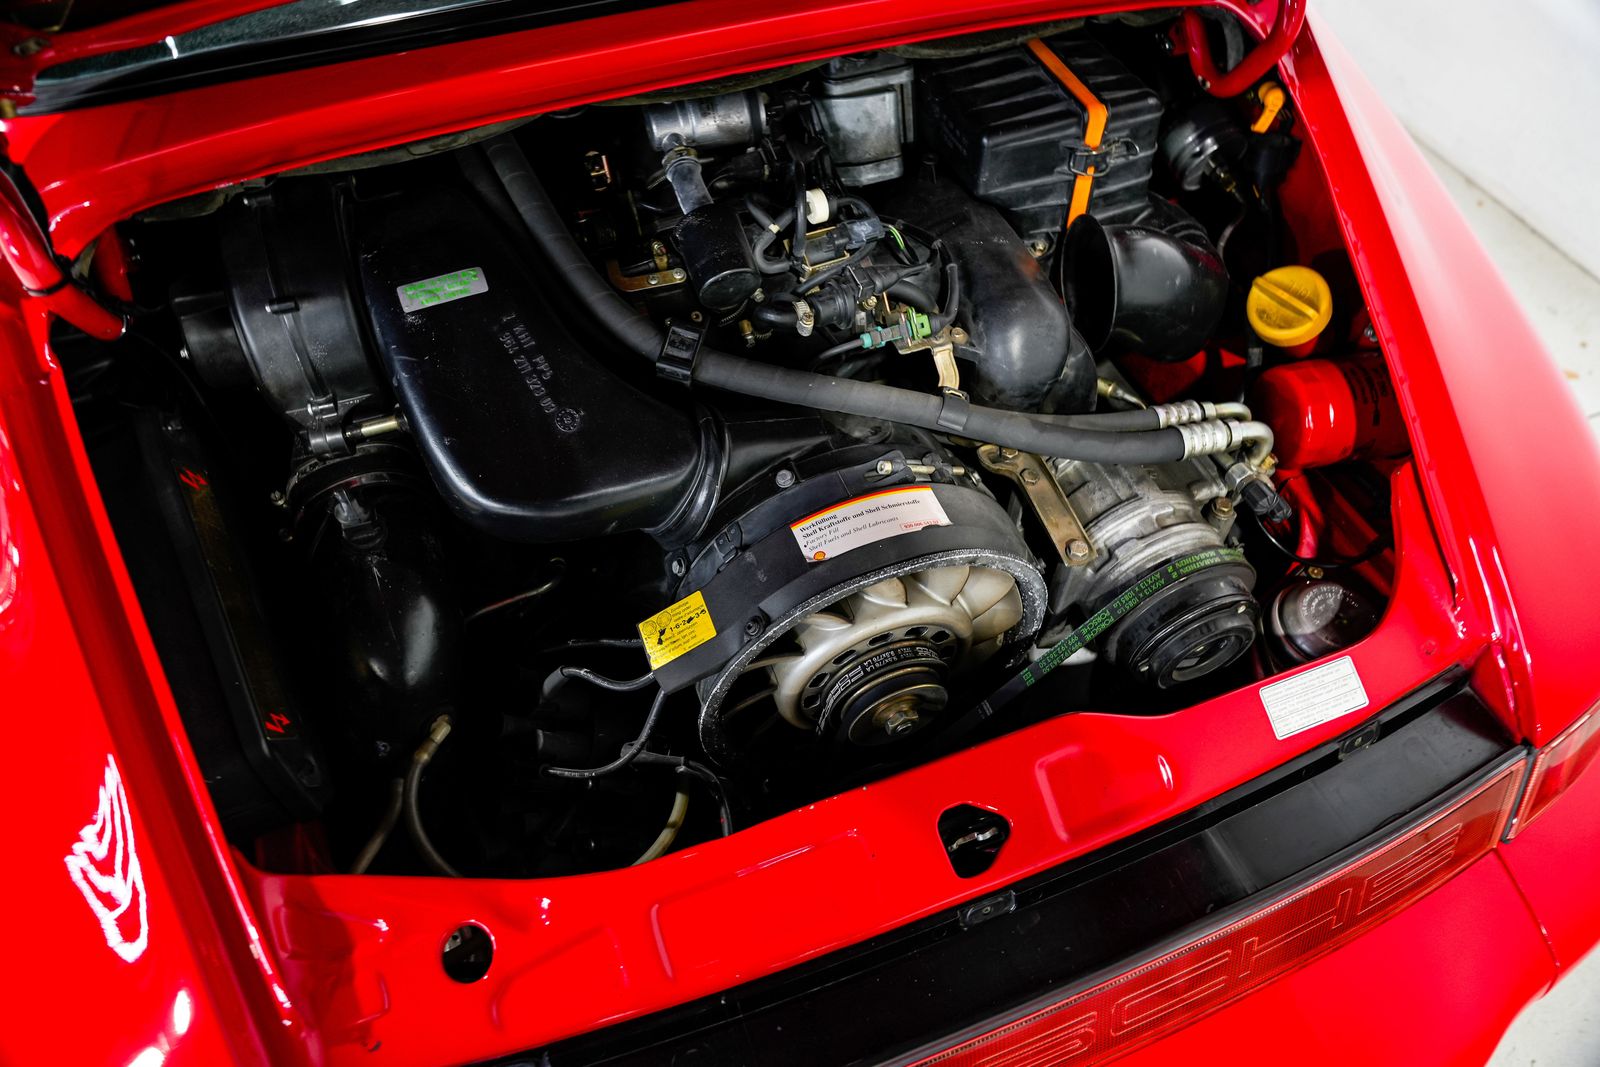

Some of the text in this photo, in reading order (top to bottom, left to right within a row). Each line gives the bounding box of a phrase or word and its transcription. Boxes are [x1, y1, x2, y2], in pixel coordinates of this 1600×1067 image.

[802, 500, 920, 540] Shell Kraftstoffe und Shell Schmierstoffe
[852, 524, 868, 534] Shell
[1081, 608, 1110, 634] PORSCHE
[1085, 614, 1114, 641] PORSCHE
